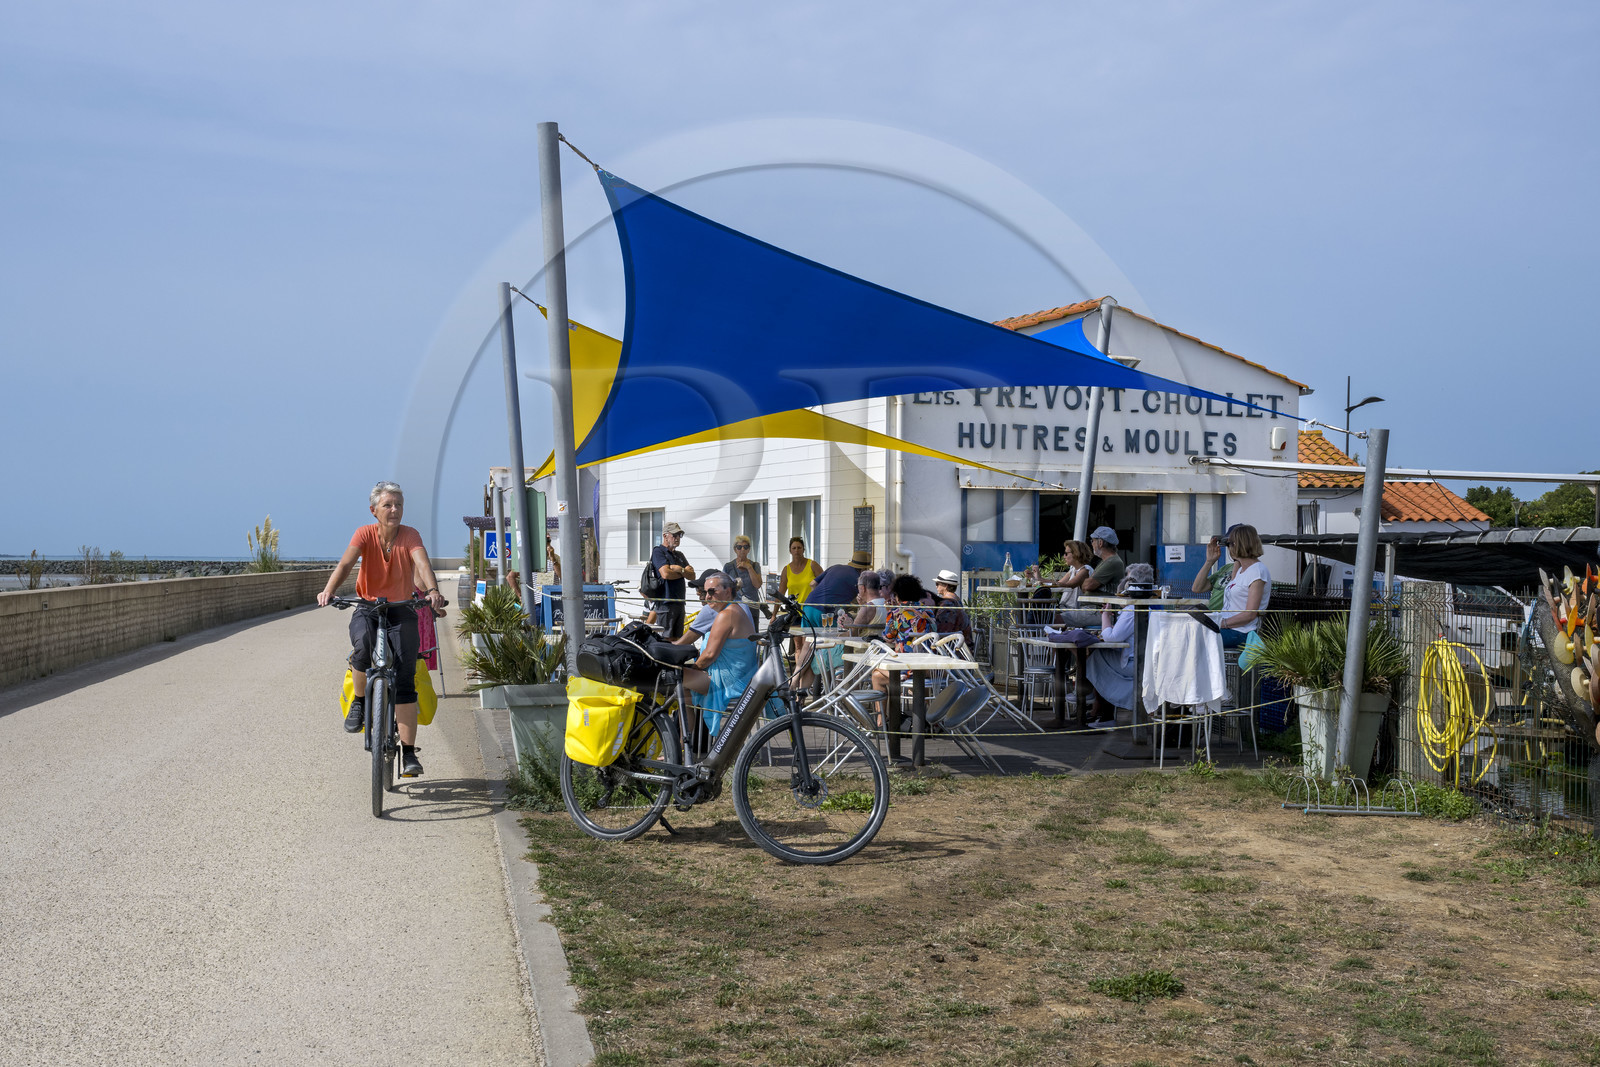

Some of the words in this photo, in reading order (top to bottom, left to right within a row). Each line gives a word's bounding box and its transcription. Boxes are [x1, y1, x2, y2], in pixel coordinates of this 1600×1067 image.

[957, 422, 1087, 452] HUITRES
[1102, 435, 1114, 453] &
[1125, 429, 1237, 457] MOULES
[714, 727, 732, 753] LOCATION
[737, 688, 755, 715] CHARENTE
